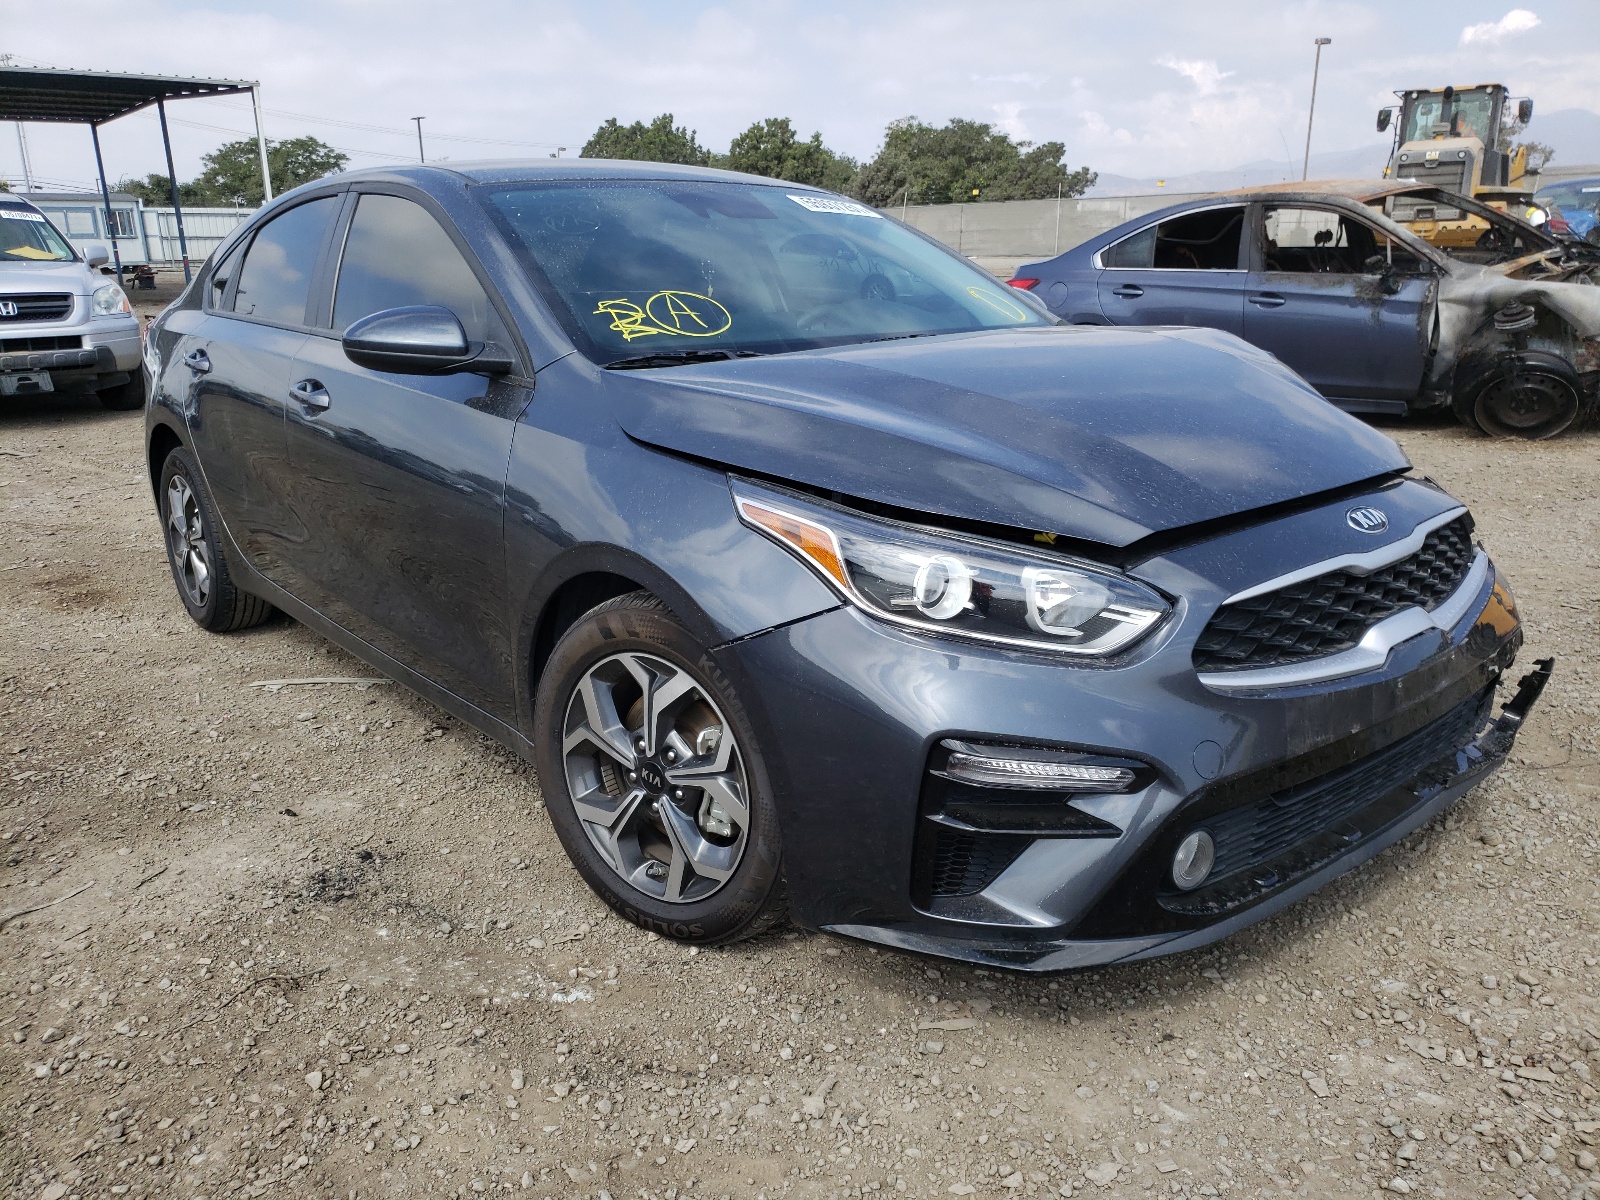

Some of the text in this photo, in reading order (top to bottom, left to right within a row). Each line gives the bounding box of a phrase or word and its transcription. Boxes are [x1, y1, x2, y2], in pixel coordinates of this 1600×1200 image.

[1426, 151, 1440, 160] CAT
[1350, 509, 1386, 529] KIA
[641, 767, 661, 788] KIA
[624, 907, 705, 938] SOLUS
